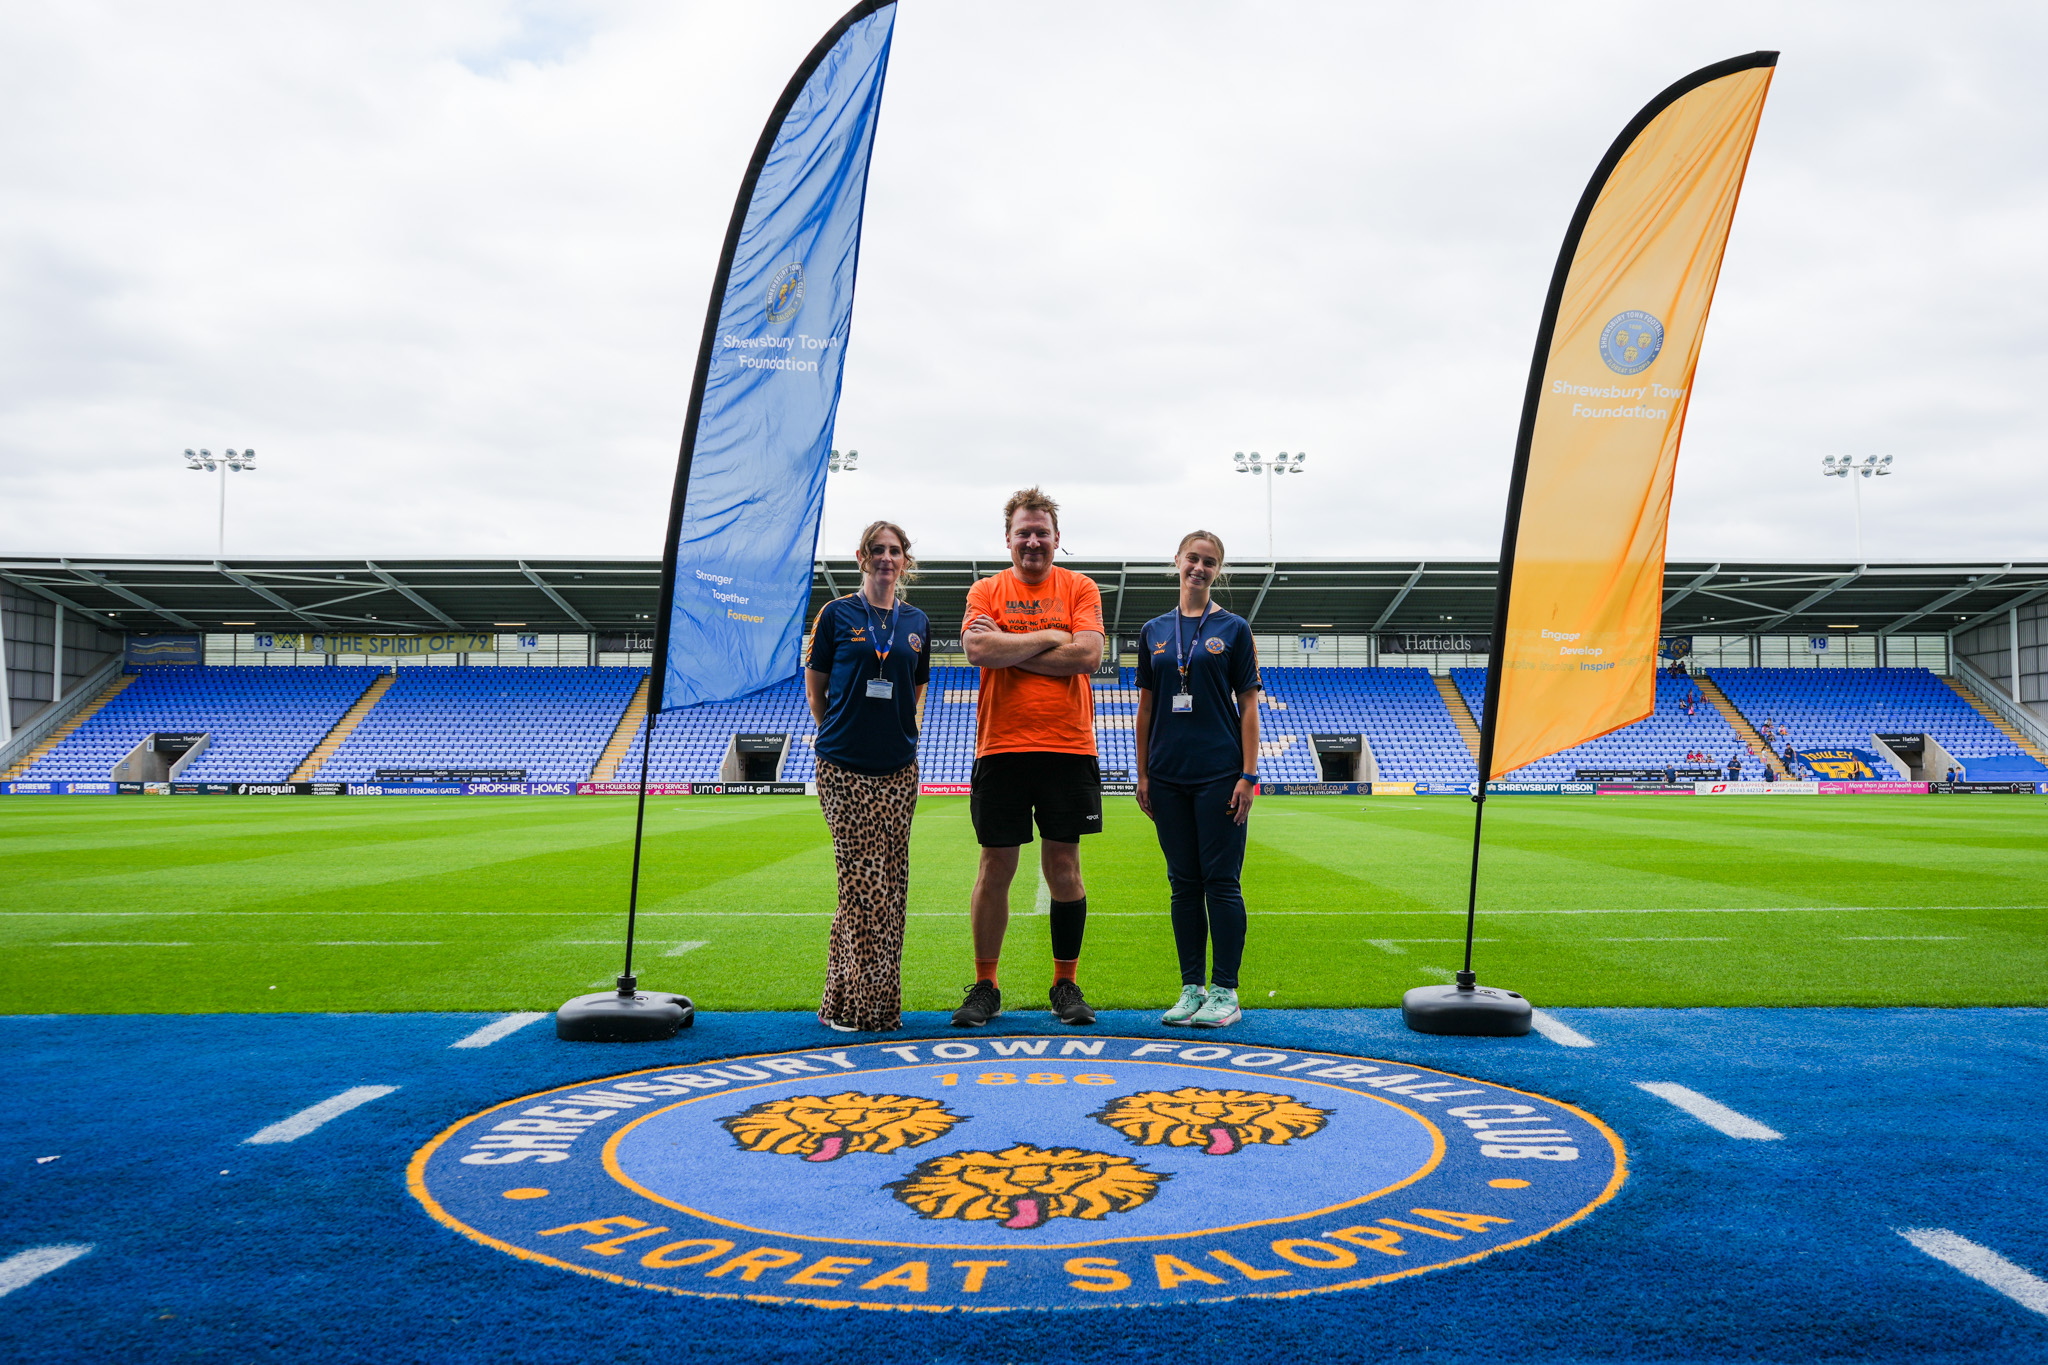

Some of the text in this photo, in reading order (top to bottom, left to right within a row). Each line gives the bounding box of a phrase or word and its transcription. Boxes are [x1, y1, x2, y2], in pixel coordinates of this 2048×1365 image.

[1600, 314, 1625, 349] SHREWSBURY
[1627, 311, 1643, 319] TOWN
[723, 334, 838, 351] Shrewsbury Town
[738, 355, 818, 372] Foundation
[1552, 380, 1647, 400] Shrewsbury
[1572, 403, 1667, 420] Foundation
[696, 569, 733, 586] Stronger
[712, 588, 749, 605] Together
[1006, 600, 1041, 609] WALK
[727, 609, 765, 623] Forever
[256, 635, 273, 647] 13
[519, 635, 536, 648] 14
[1541, 629, 1581, 642] Engage
[330, 633, 489, 653] THE SPIRIT OF '79
[1300, 637, 1317, 649] 17
[1404, 634, 1472, 651] Hatfields
[1810, 637, 1826, 649] 19
[1560, 646, 1603, 657] Develop
[1580, 661, 1615, 672] Inspire
[249, 784, 296, 795] penguin
[348, 783, 383, 795] hales
[468, 783, 528, 795] SHROPSHIRE
[531, 783, 570, 795] HOMES
[693, 783, 725, 794] umai
[728, 784, 746, 793] sushi
[756, 784, 770, 794] grill
[923, 785, 950, 794] Property
[1283, 783, 1349, 792] shukerbuild.co.uk
[1877, 782, 1888, 790] just
[931, 1072, 1118, 1086] 1886
[459, 1040, 1580, 1165] SHREWSBURY TOWN FOOTBALL CLUB
[537, 1208, 1515, 1293] FLOREAT SALOPIA
